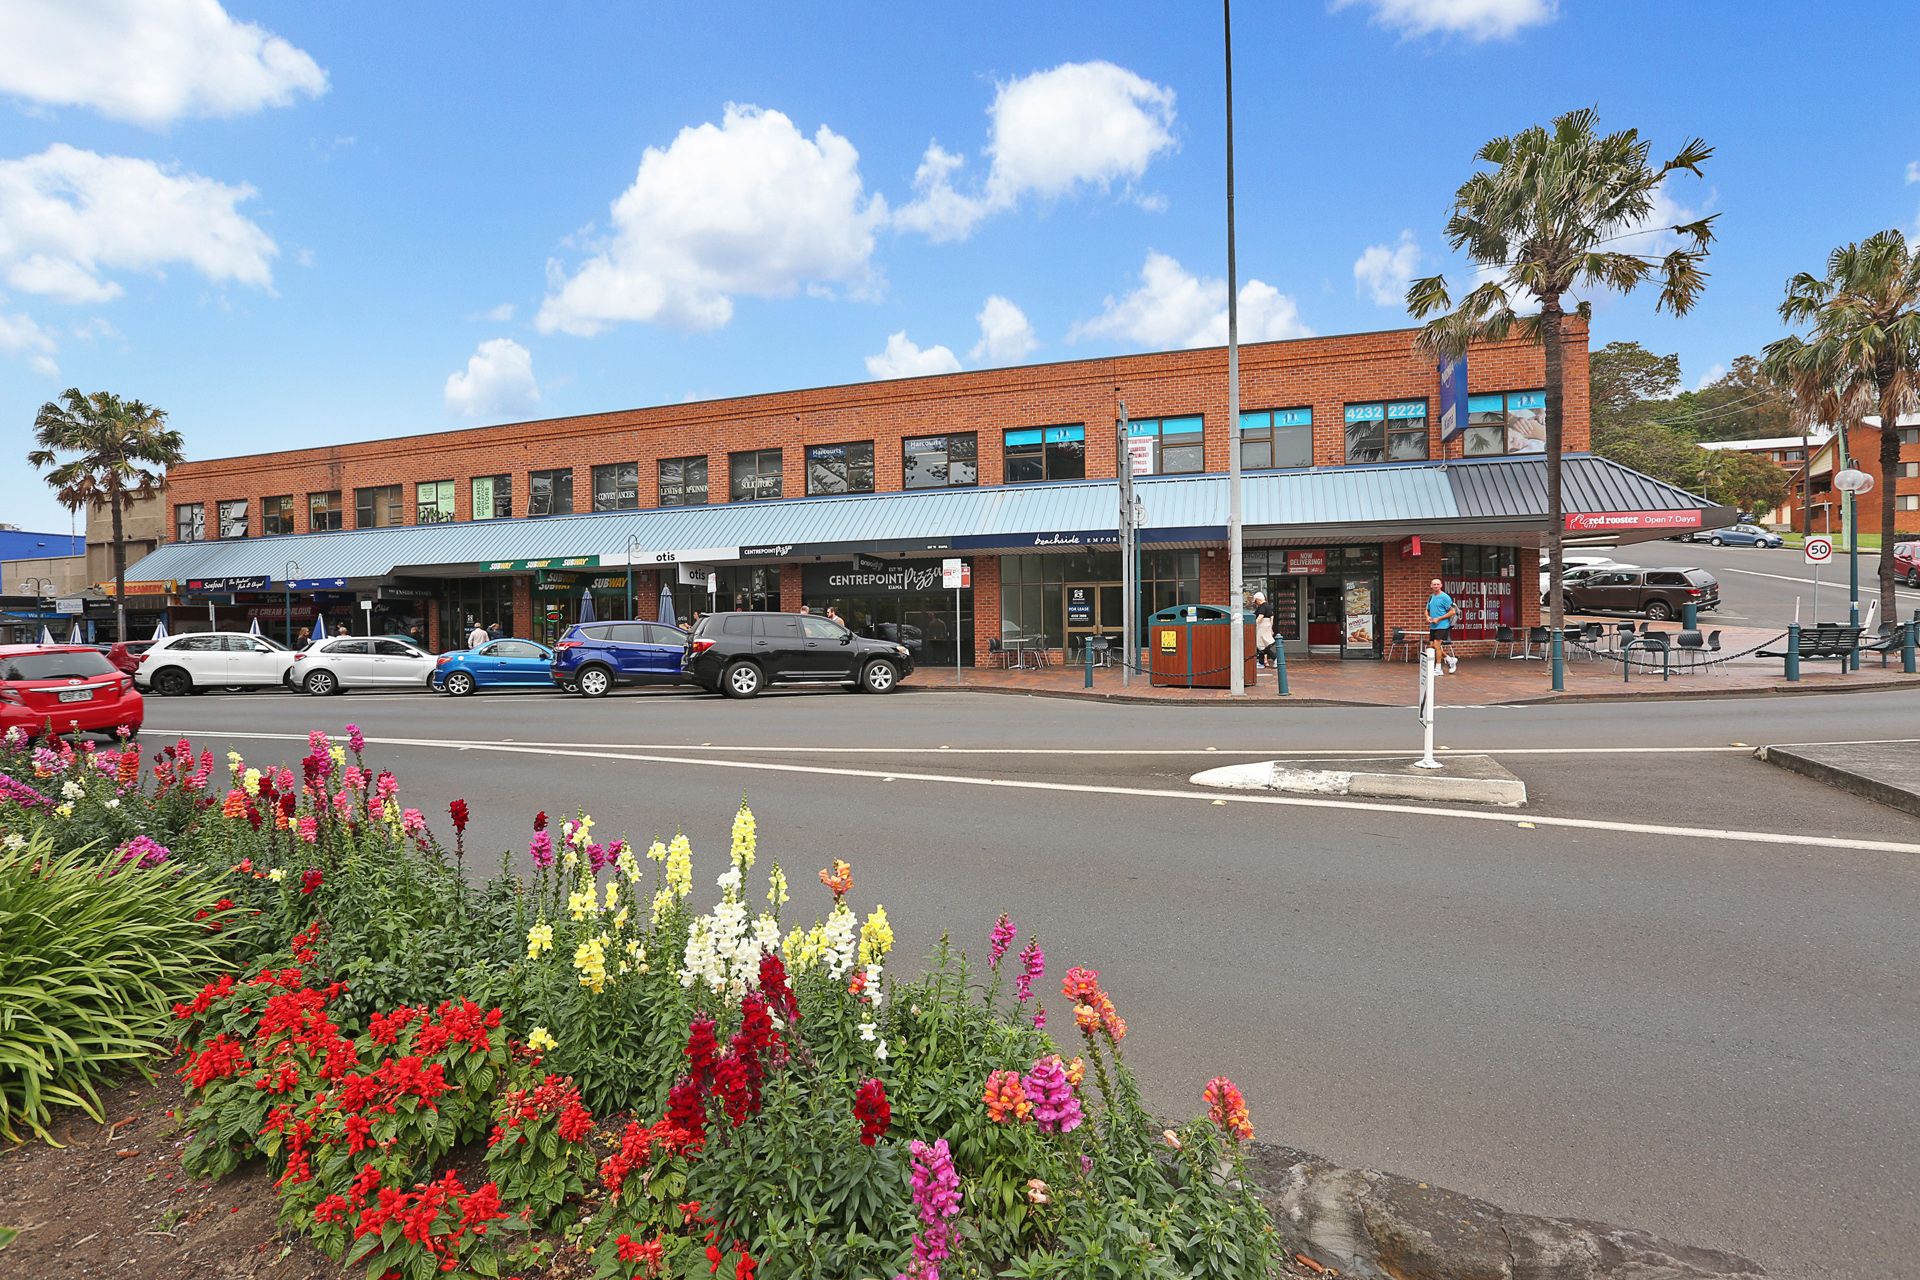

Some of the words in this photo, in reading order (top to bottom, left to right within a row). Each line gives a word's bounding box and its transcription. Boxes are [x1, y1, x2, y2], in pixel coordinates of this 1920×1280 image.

[1347, 406, 1382, 419] 4232
[1389, 404, 1424, 416] 2222
[910, 439, 941, 448] Harcourts
[813, 448, 842, 456] Harcourts
[741, 480, 774, 489] SOLICITORS
[598, 490, 635, 501] CONVEYANCERS
[1589, 516, 1605, 524] red
[1605, 516, 1639, 524] rooster
[1644, 516, 1666, 524] Open
[1675, 515, 1696, 523] Days
[1034, 533, 1080, 545] beachside
[744, 548, 776, 556] CENTREPOINT
[775, 545, 792, 557] Pizza
[1811, 545, 1827, 554] 50
[656, 551, 676, 562] otis
[489, 562, 514, 570] SUBWAY
[525, 560, 551, 569] SUBWAY
[562, 558, 589, 566] SUBWAY
[1290, 558, 1323, 566] DELIVERING!
[690, 569, 706, 580] otis
[829, 574, 904, 586] CENTREPOINT
[904, 567, 943, 591] Pizza
[591, 577, 628, 589] SUBWAY
[1445, 582, 1465, 594] NOW
[1466, 582, 1511, 595] DELIVERING
[1453, 598, 1474, 608] uch
[1475, 598, 1480, 608] &
[1484, 598, 1501, 608] inne
[248, 608, 259, 616] ICE
[260, 608, 282, 616] CREAM
[283, 607, 312, 616] PRLOUR
[1459, 610, 1476, 621] Oder
[1478, 610, 1499, 620] Oline
